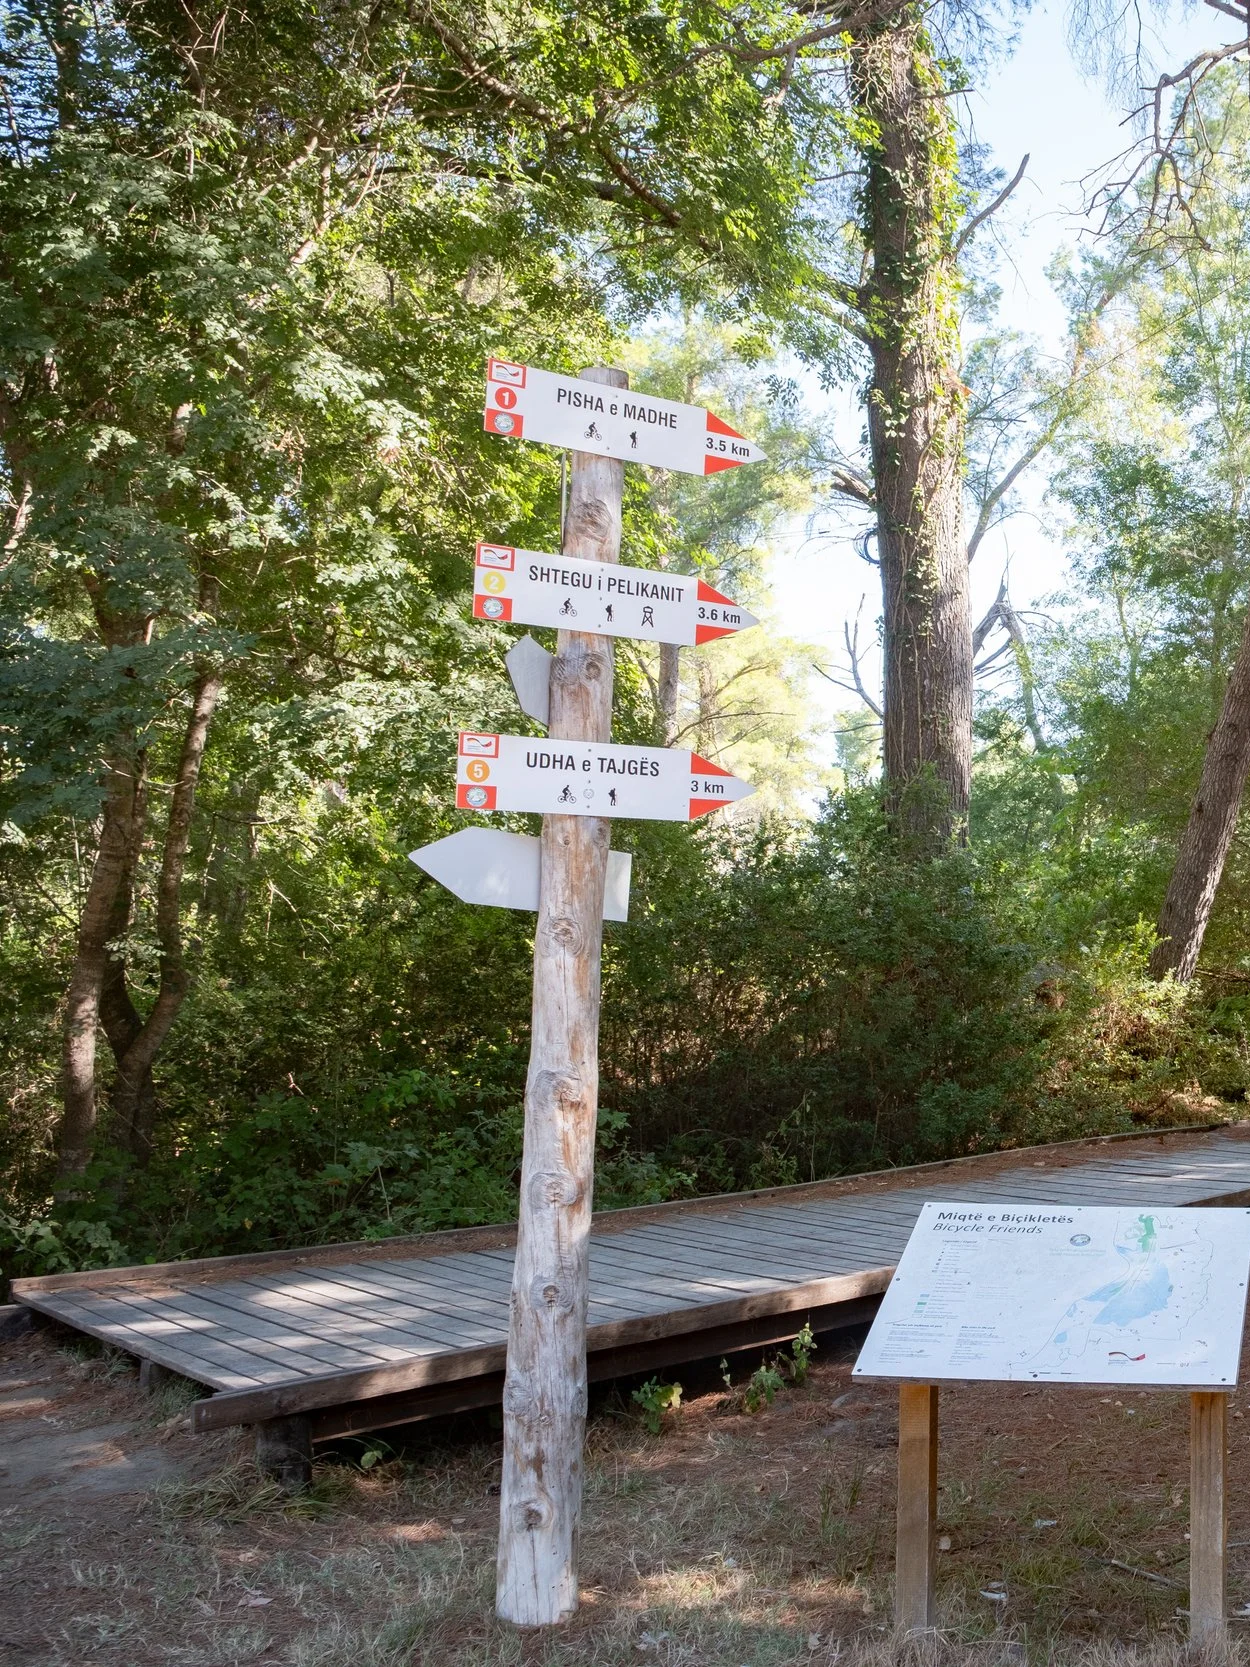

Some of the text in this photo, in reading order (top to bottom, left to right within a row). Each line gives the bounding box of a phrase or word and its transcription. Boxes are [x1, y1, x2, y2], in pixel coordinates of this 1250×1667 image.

[502, 391, 510, 406] 1
[556, 387, 678, 429] PISHA e MADHE
[705, 437, 750, 458] 3.5 km
[489, 575, 499, 590] 2
[528, 565, 685, 603] SHTEGU i PELIKANIT
[697, 607, 741, 624] 3.6 km
[473, 763, 483, 778] 5
[526, 752, 660, 777] UDHA e TAJGËS
[690, 780, 724, 794] 3 km
[937, 1212, 983, 1222] Miqtë
[1001, 1214, 1074, 1224] Biçikletës
[933, 1222, 1044, 1234] Bicycle Friends
